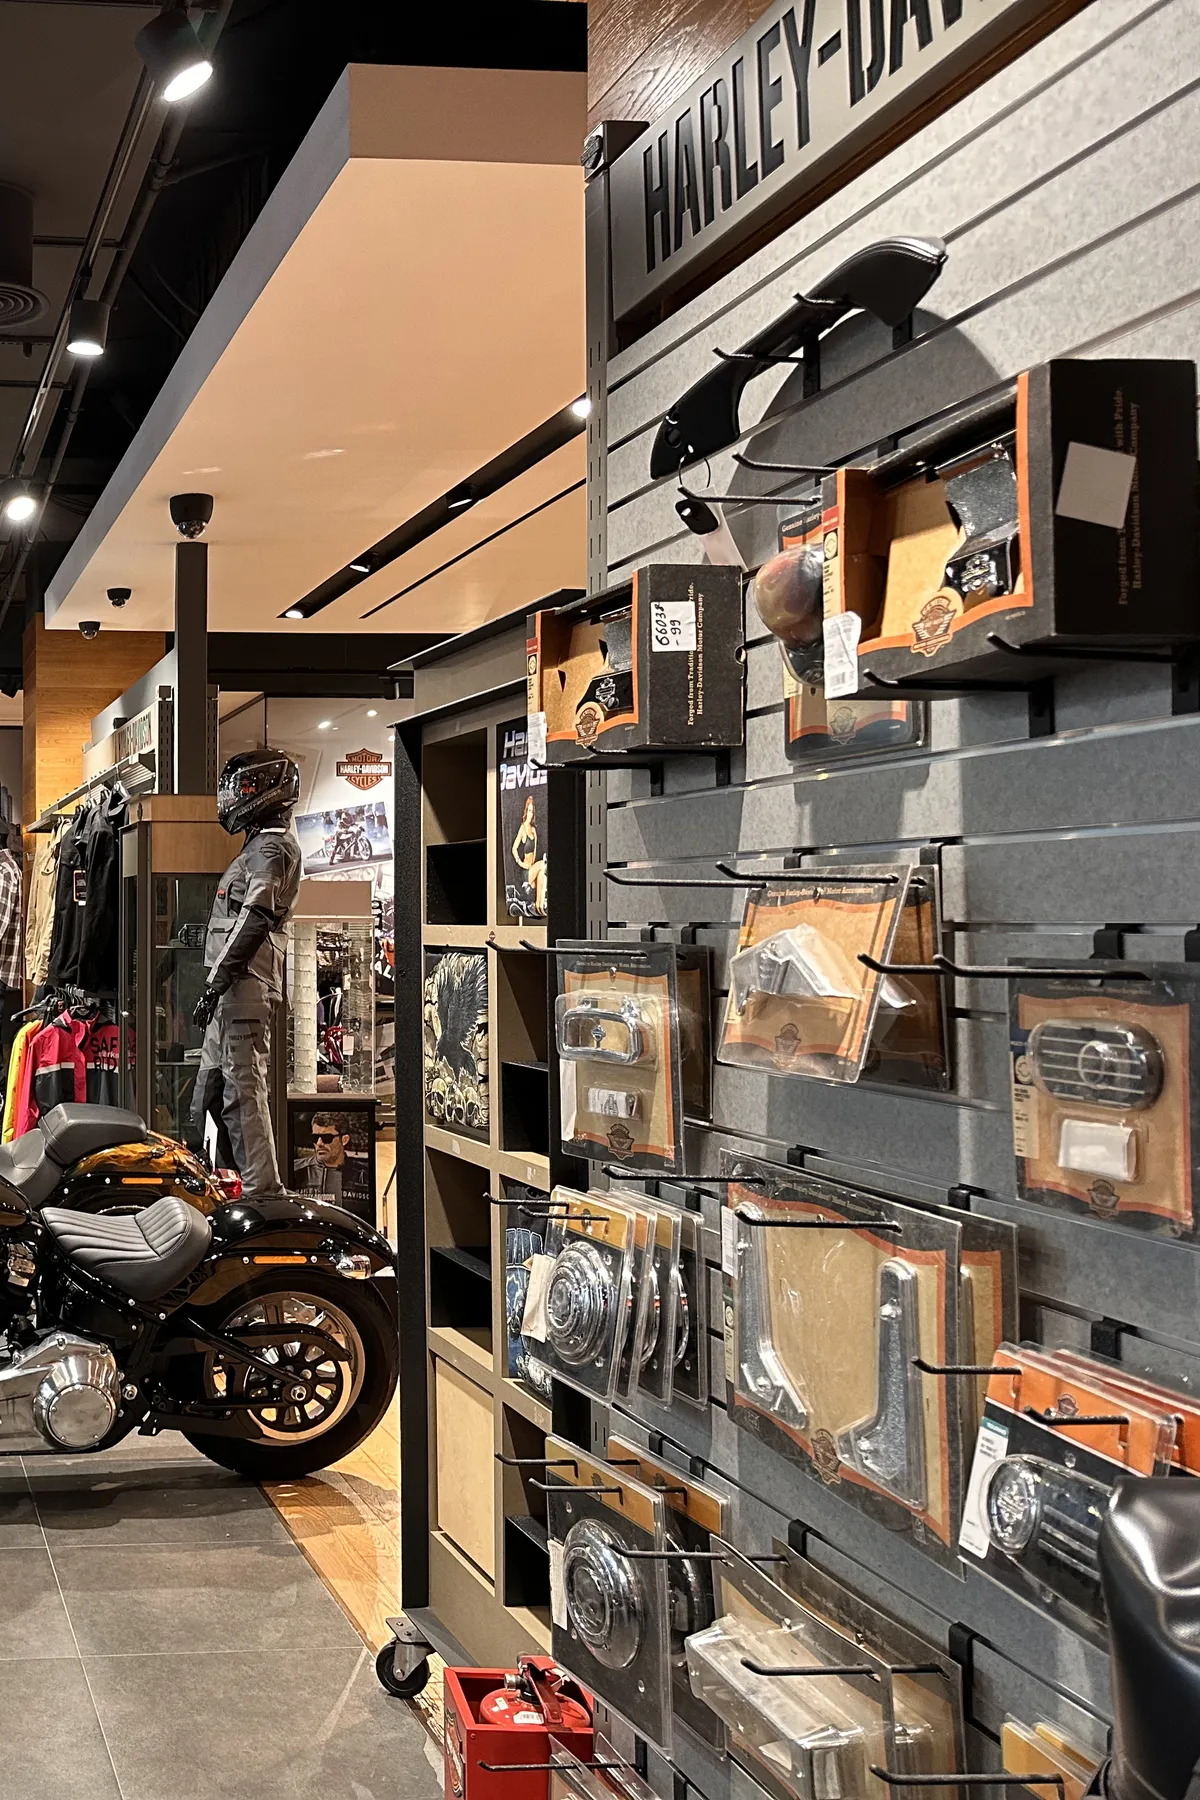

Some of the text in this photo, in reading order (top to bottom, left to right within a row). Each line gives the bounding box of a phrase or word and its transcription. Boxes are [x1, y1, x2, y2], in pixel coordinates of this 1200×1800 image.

[687, 650, 695, 681] Traditio
[687, 681, 695, 699] from
[687, 700, 695, 725] Forged
[351, 752, 377, 762] MOTOR
[339, 764, 389, 774] HARLEY-DAVIDSON
[351, 776, 377, 788] CYCLES
